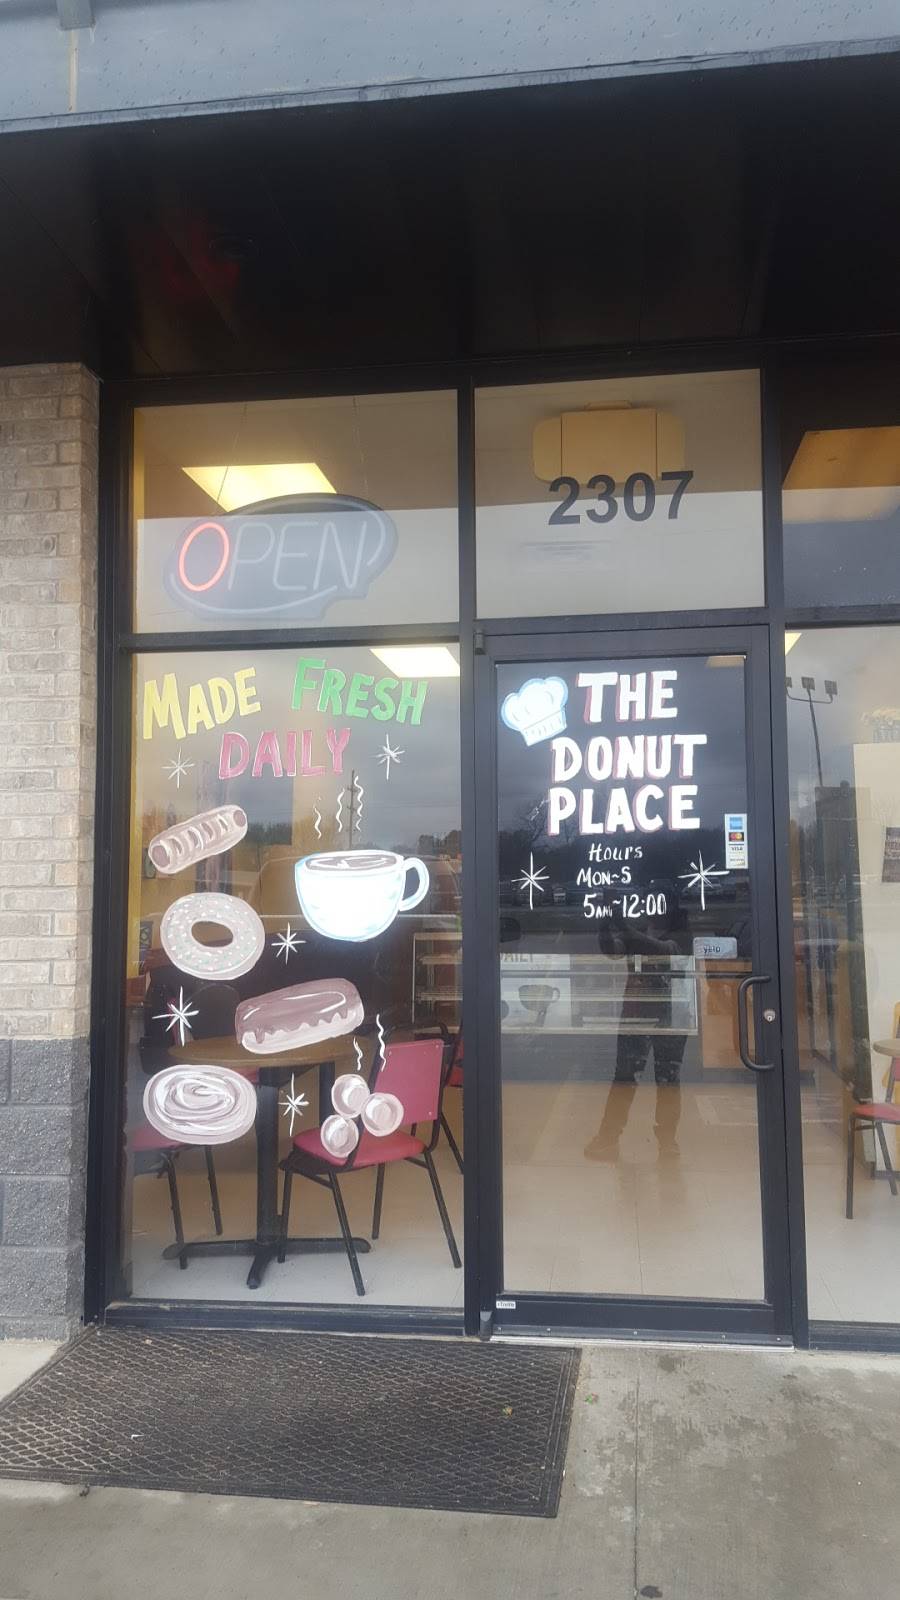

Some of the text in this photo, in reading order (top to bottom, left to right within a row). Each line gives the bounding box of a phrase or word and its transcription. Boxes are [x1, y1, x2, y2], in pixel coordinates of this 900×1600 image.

[548, 470, 694, 525] 2307
[178, 521, 367, 592] OPEN
[143, 656, 429, 740] MADE FRESH
[576, 670, 678, 724] THE
[218, 728, 352, 779] DAILY
[551, 734, 708, 783] DONUT
[547, 784, 701, 836] PLACE
